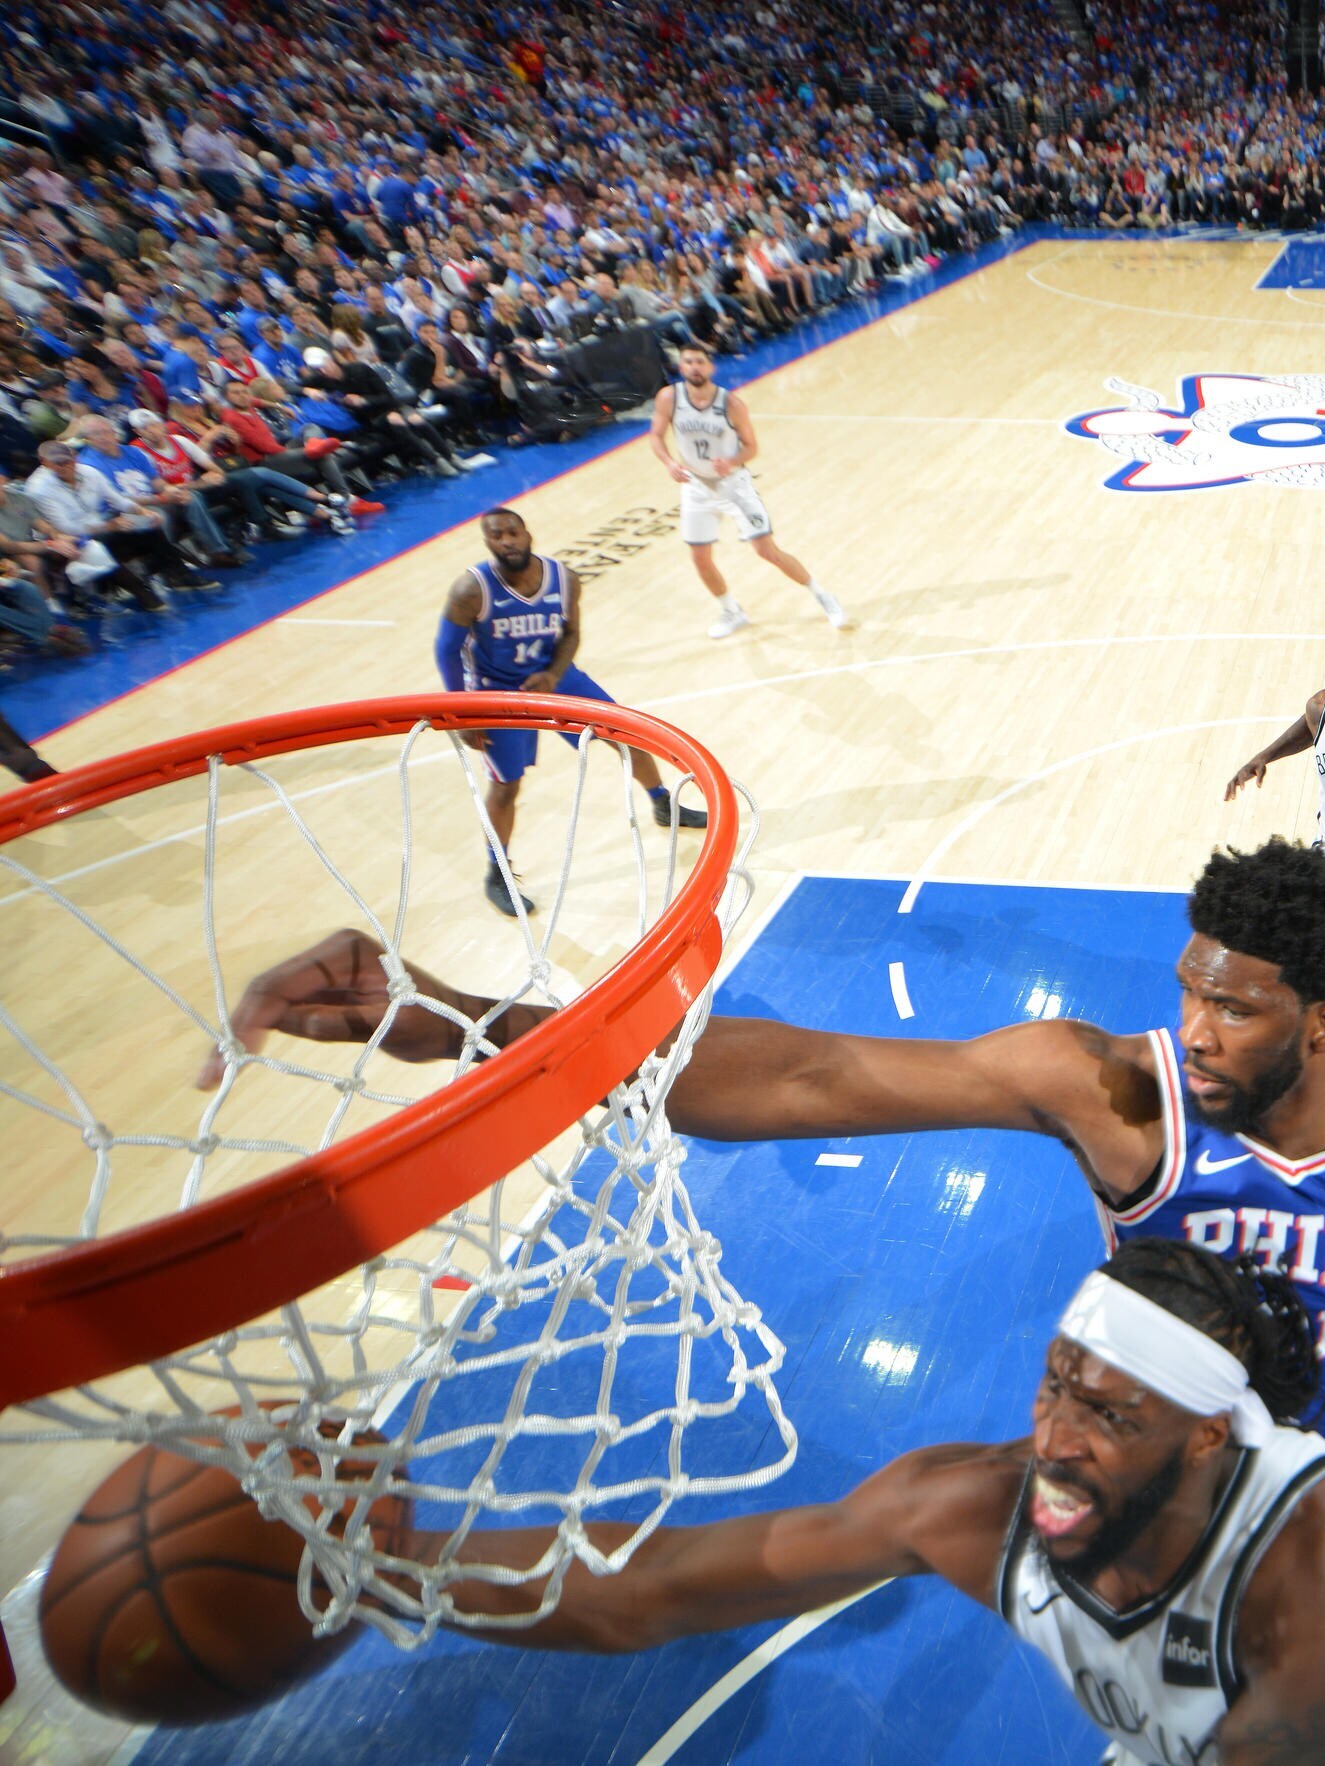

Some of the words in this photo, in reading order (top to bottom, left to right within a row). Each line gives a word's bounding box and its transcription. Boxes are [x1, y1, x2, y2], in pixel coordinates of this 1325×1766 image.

[693, 438, 711, 460] 12
[492, 612, 564, 639] PHILA
[513, 639, 545, 664] 14
[1165, 1633, 1210, 1668] infor
